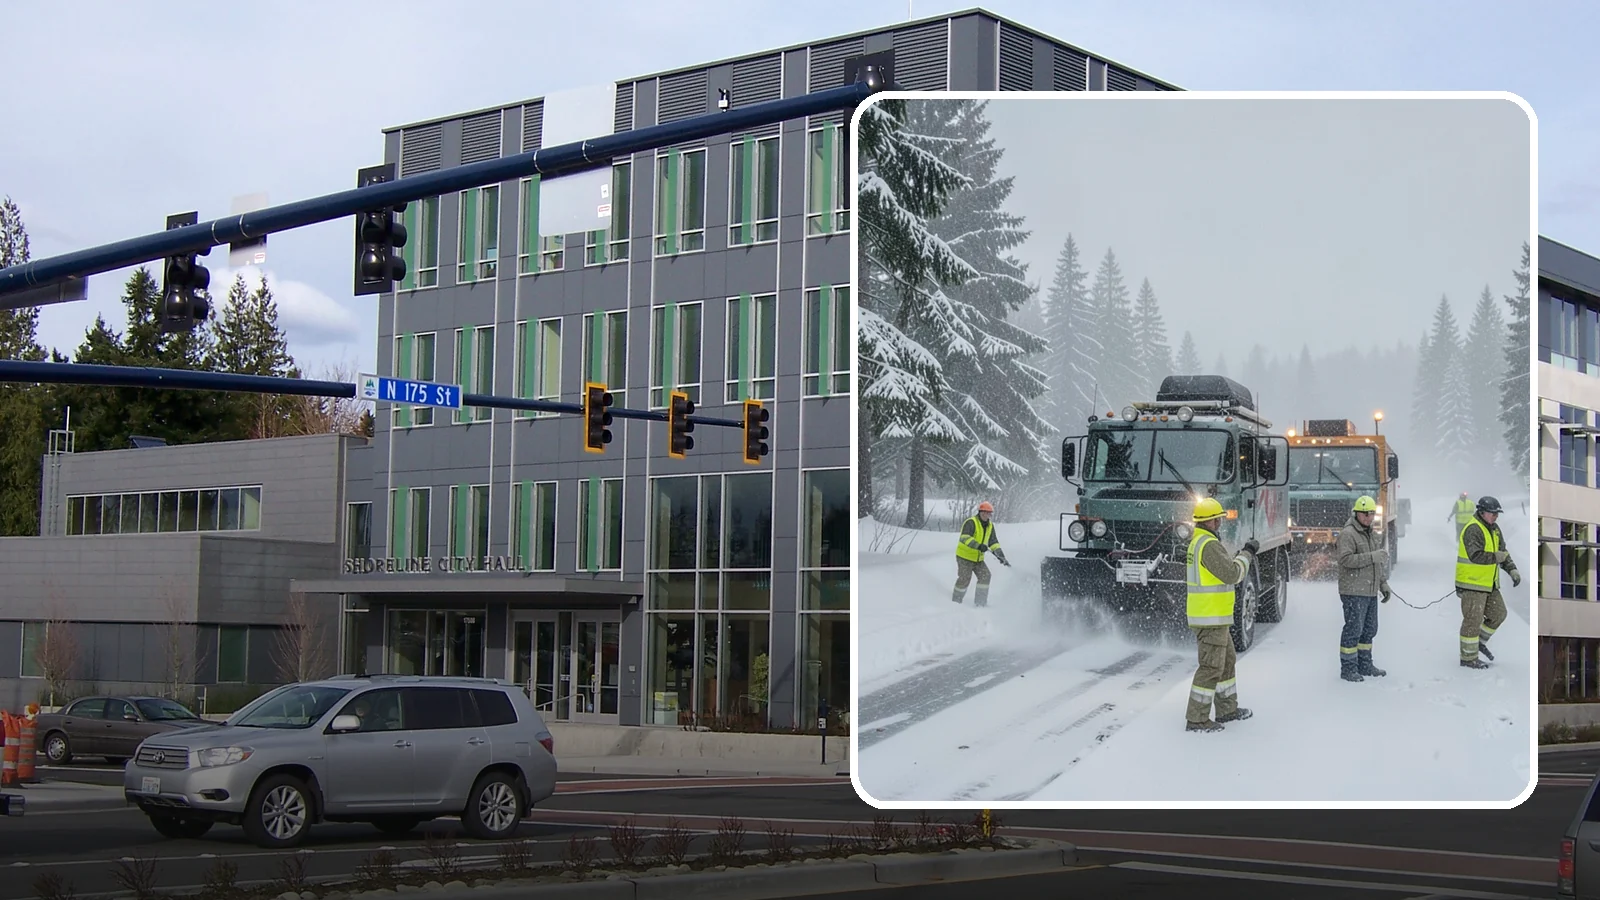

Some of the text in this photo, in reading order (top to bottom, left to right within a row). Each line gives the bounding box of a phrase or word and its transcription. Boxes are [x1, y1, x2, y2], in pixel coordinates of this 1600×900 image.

[387, 381, 451, 406] N 175 St
[344, 555, 527, 574] SHORELINE CITY HALL
